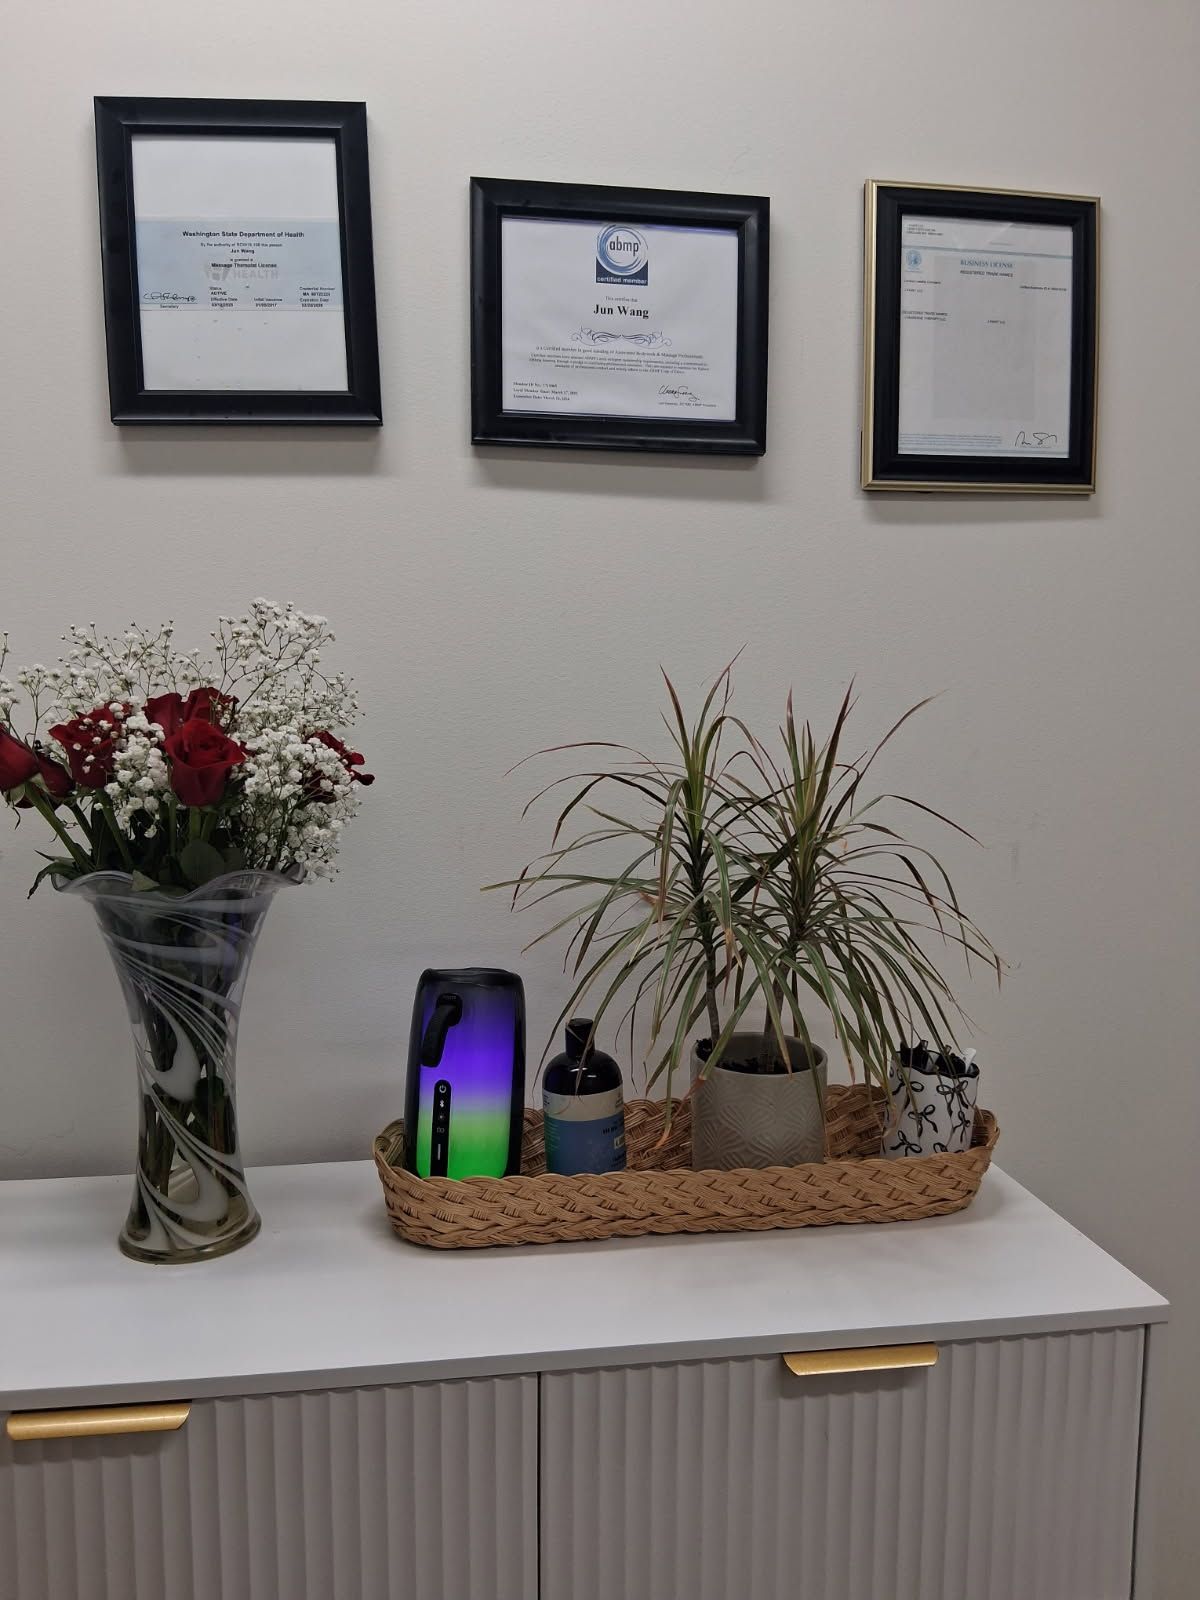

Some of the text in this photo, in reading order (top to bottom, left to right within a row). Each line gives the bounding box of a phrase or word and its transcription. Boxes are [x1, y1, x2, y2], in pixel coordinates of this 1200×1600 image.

[182, 230, 220, 239] Washington
[239, 231, 275, 239] Department
[609, 235, 640, 257] abmp
[960, 259, 988, 267] BUSINESS
[233, 269, 279, 281] HEALTH
[593, 304, 649, 320] Jun Wang
